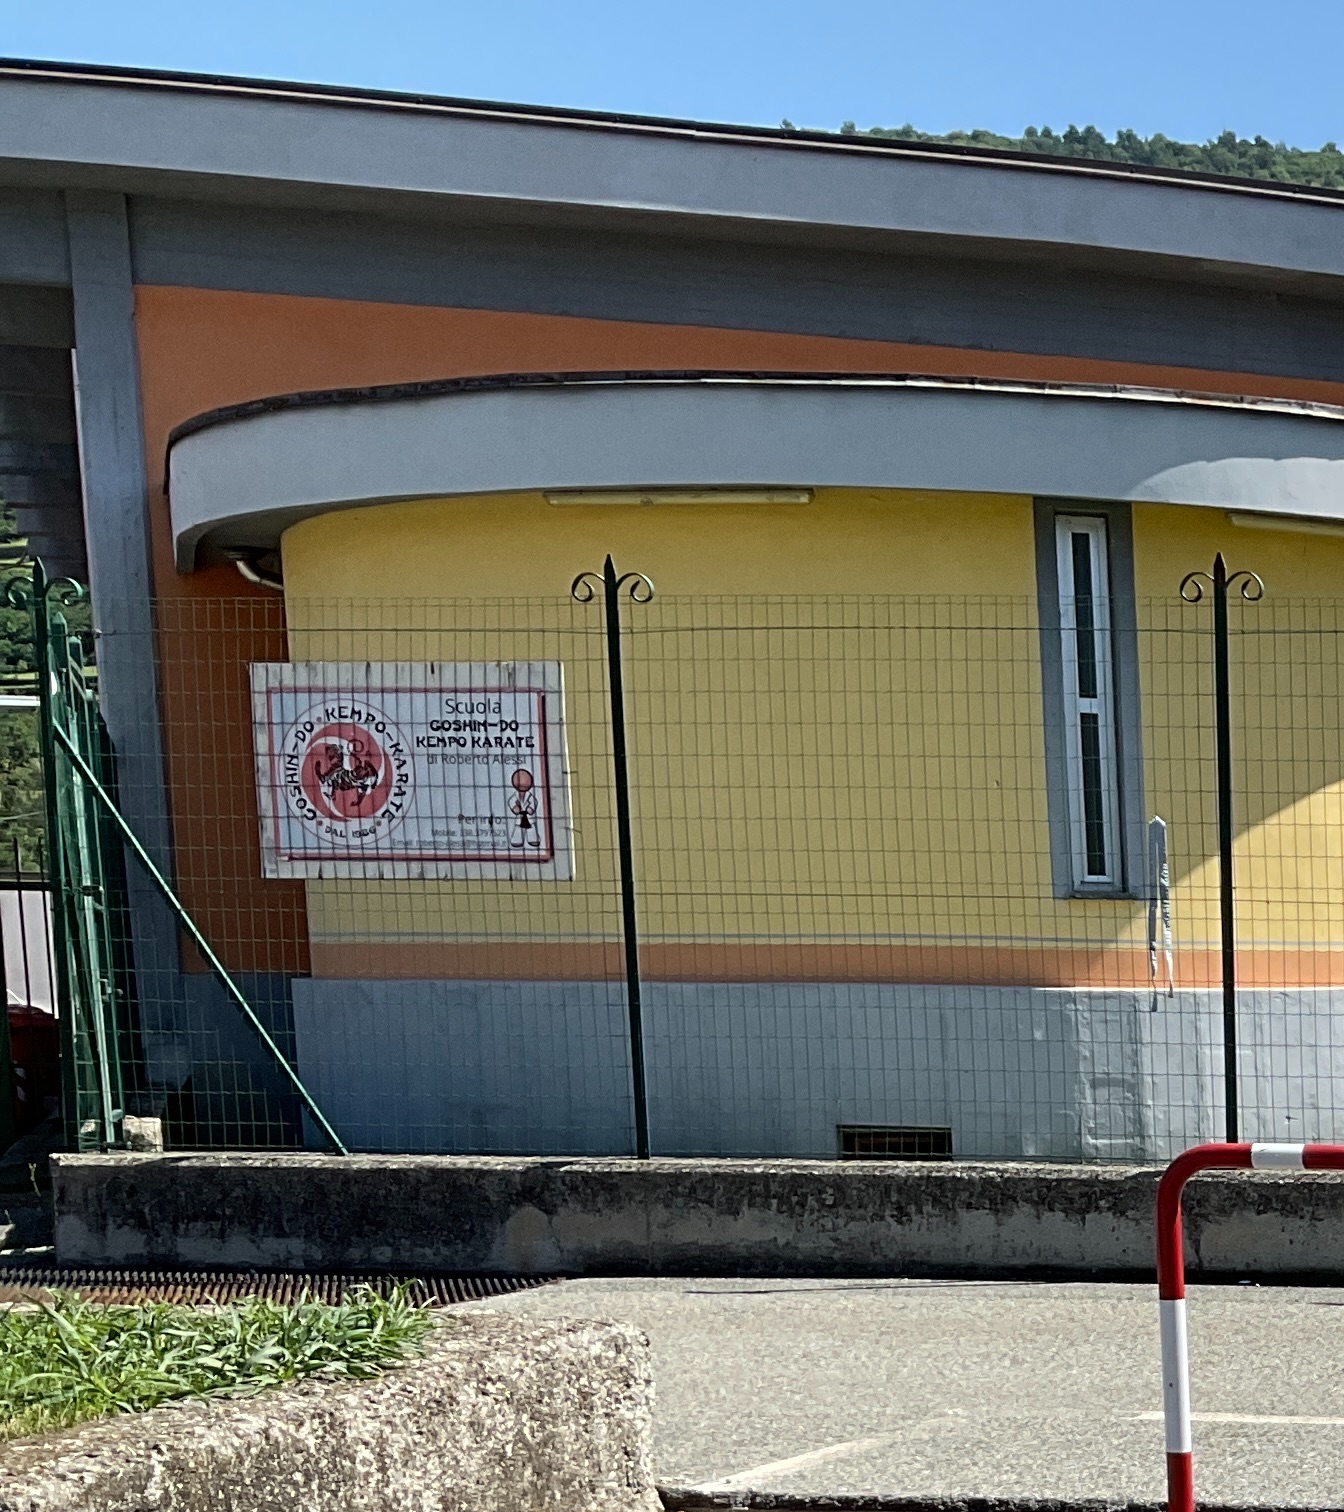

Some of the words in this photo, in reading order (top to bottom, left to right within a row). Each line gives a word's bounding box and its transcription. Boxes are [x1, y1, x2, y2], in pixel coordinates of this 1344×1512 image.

[445, 697, 501, 714] Scuola
[430, 720, 519, 733] GOSHIN-DO
[416, 735, 467, 748] KEMPO
[471, 735, 535, 749] KARATE
[442, 753, 489, 765] Roberto
[492, 753, 527, 766] Alessi
